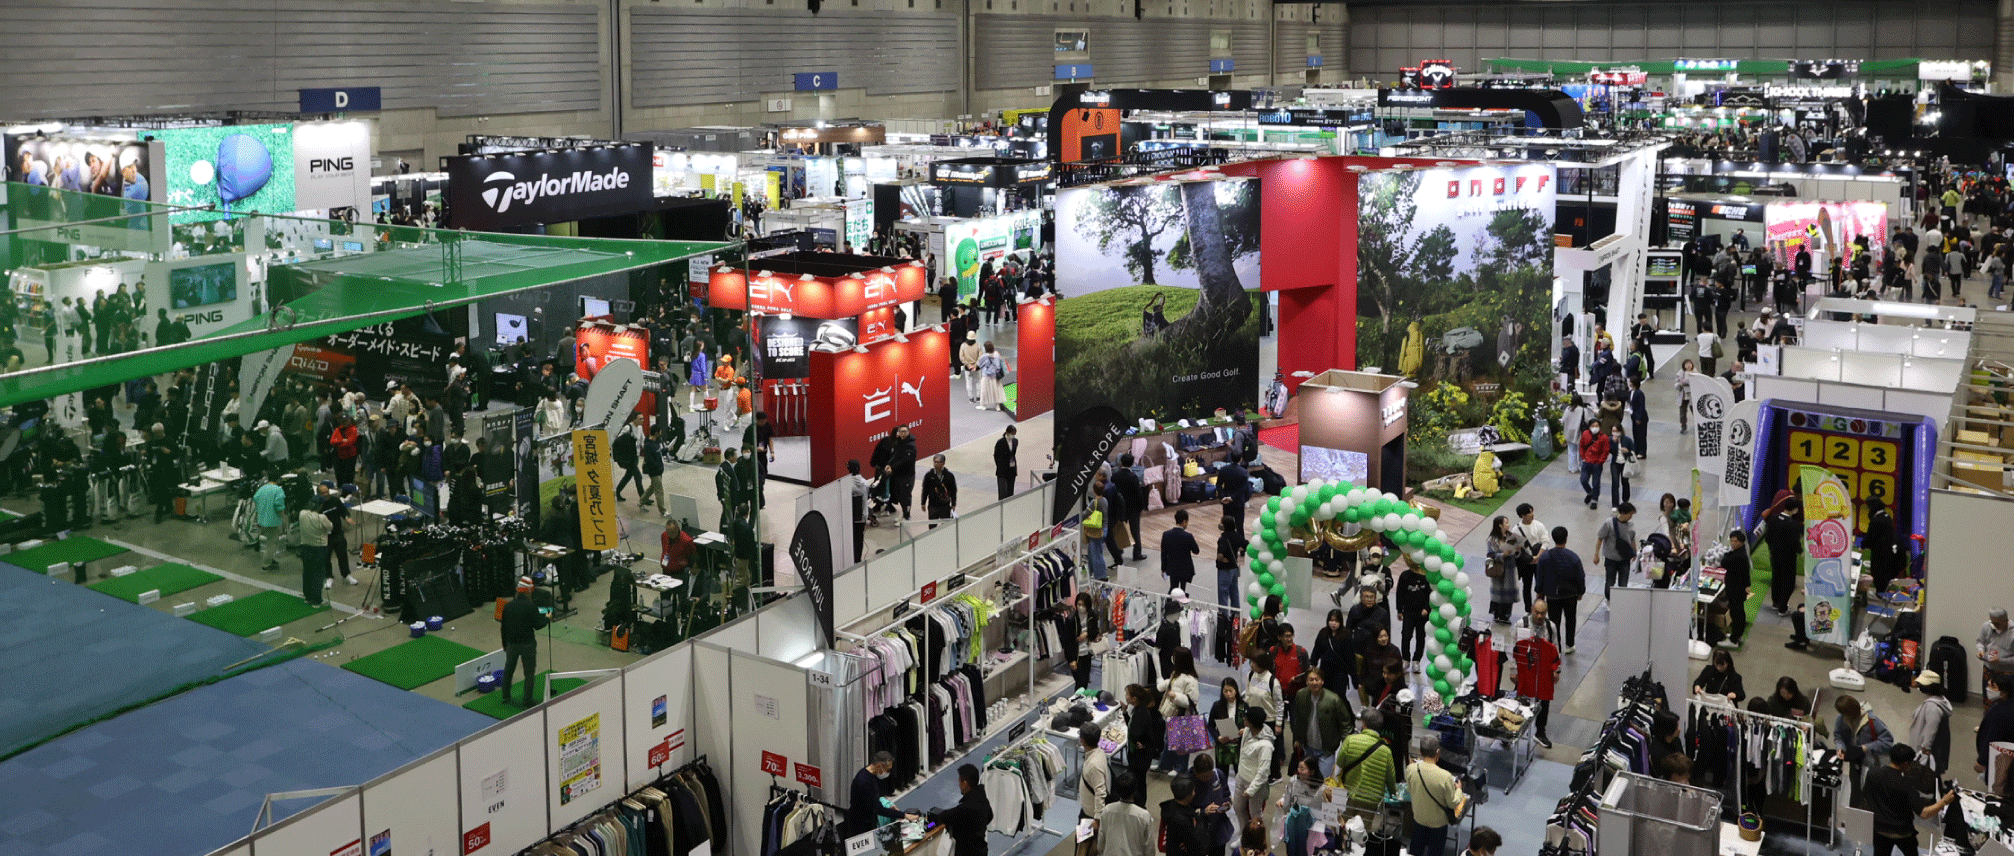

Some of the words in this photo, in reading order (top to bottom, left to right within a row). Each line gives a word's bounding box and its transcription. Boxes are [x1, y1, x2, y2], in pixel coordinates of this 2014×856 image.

[813, 75, 821, 88] C
[335, 91, 349, 108] D
[310, 157, 354, 173] PING
[481, 166, 630, 214] TaylorMade
[57, 228, 81, 241] PING
[184, 310, 223, 325] PING
[353, 321, 395, 337] 立てる
[327, 333, 442, 363] オーダーメイド・スピード
[767, 346, 778, 358] TO
[778, 346, 805, 357] SCORE
[1172, 373, 1199, 384] Create
[1200, 370, 1222, 381] Good
[1223, 367, 1241, 378] Golf.
[611, 378, 633, 411] SHAFT
[908, 418, 923, 430] GOLF
[869, 430, 890, 443] COBRA
[1799, 439, 1812, 458] 1
[1833, 441, 1850, 461] 2
[1870, 446, 1887, 465] 3
[1868, 478, 1886, 498] 6
[383, 569, 391, 600] N.S.PRO
[812, 673, 830, 685] 1-34
[488, 800, 505, 814] EVEN
[852, 838, 870, 851] EVEN
